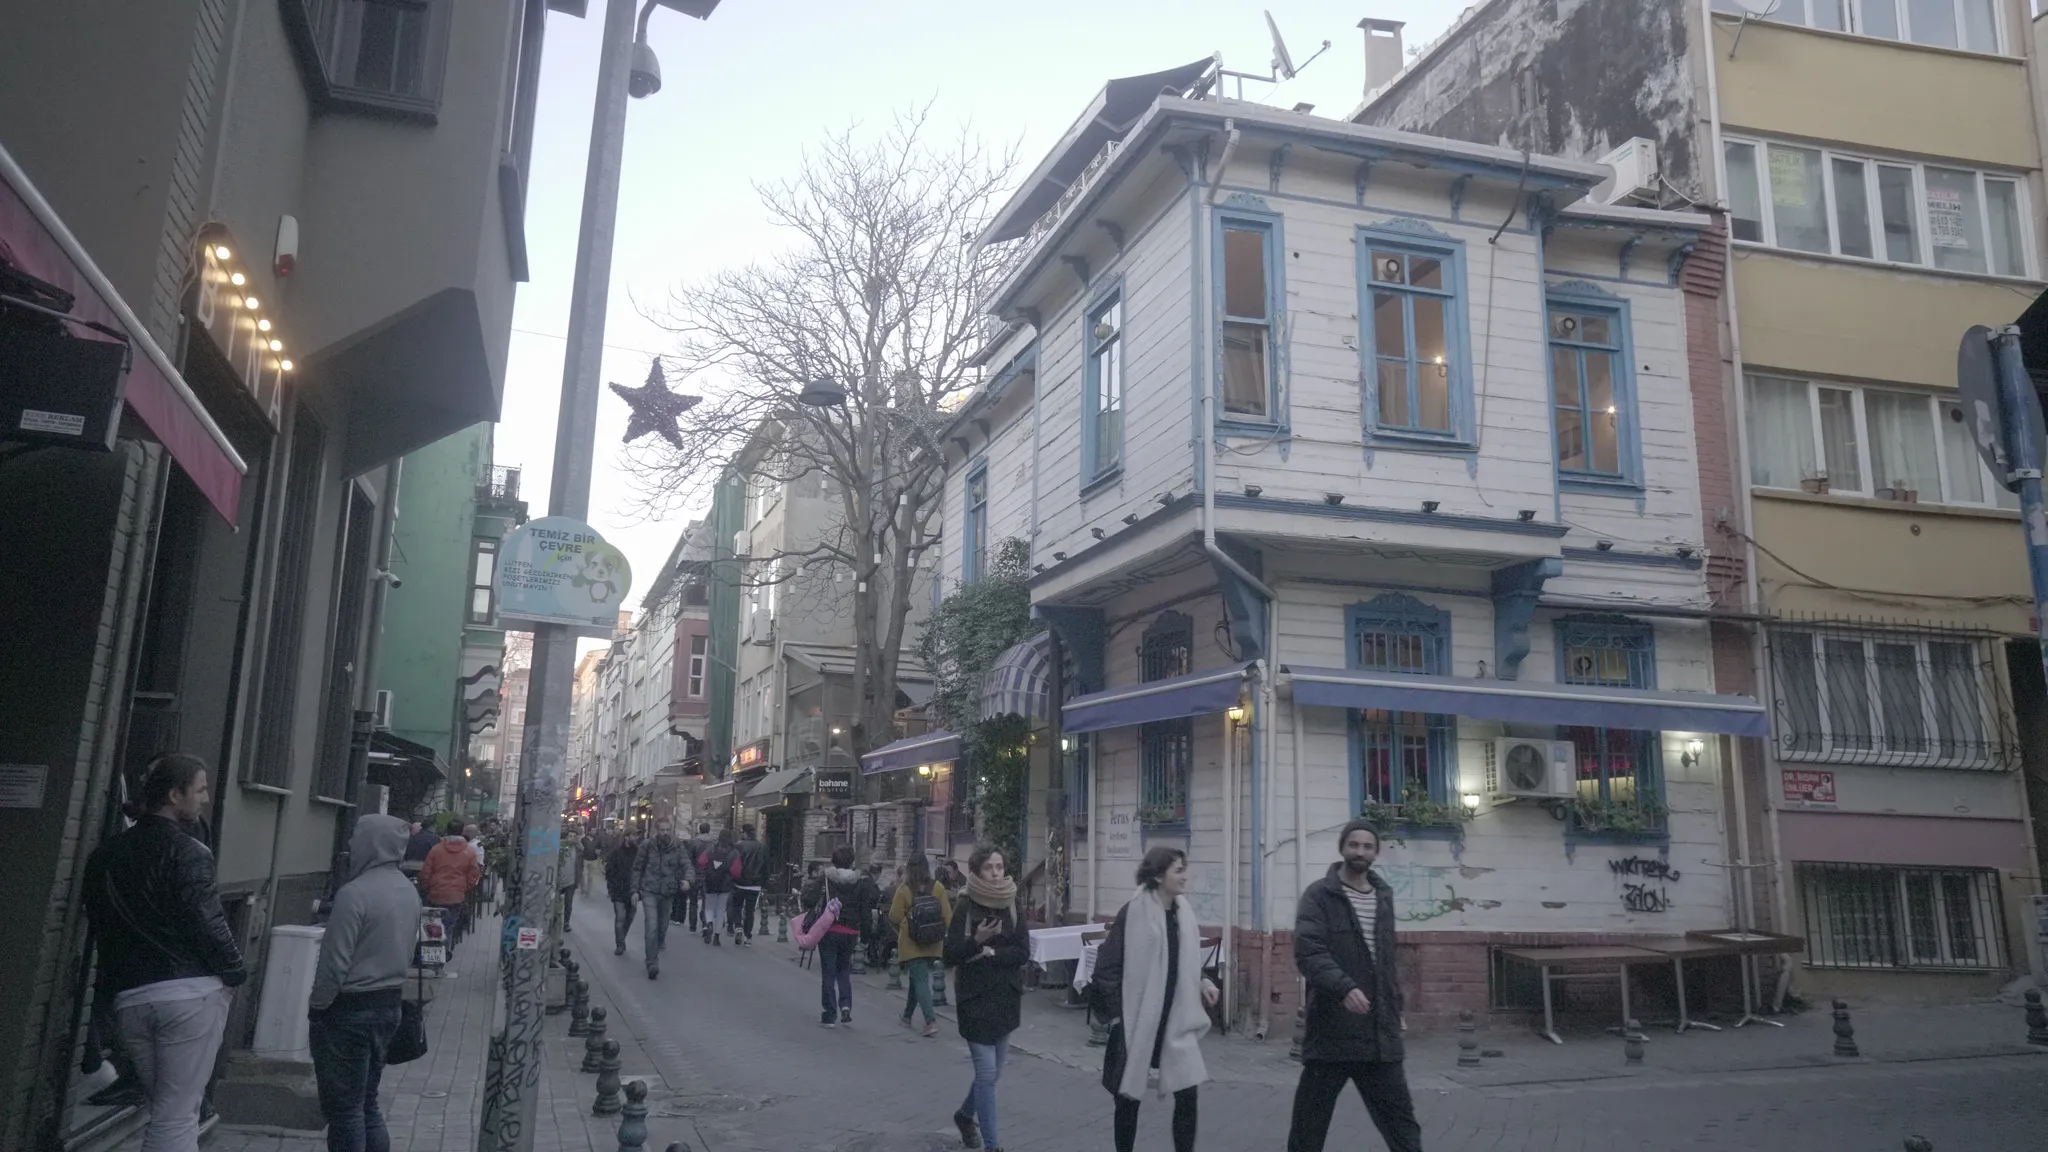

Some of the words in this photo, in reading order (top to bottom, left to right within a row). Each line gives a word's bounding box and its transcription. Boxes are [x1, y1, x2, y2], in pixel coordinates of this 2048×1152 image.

[47, 413, 83, 423] REKLAM
[530, 527, 570, 541] TEMİZ
[573, 532, 596, 545] BİR
[539, 540, 582, 554] ÇEVRE
